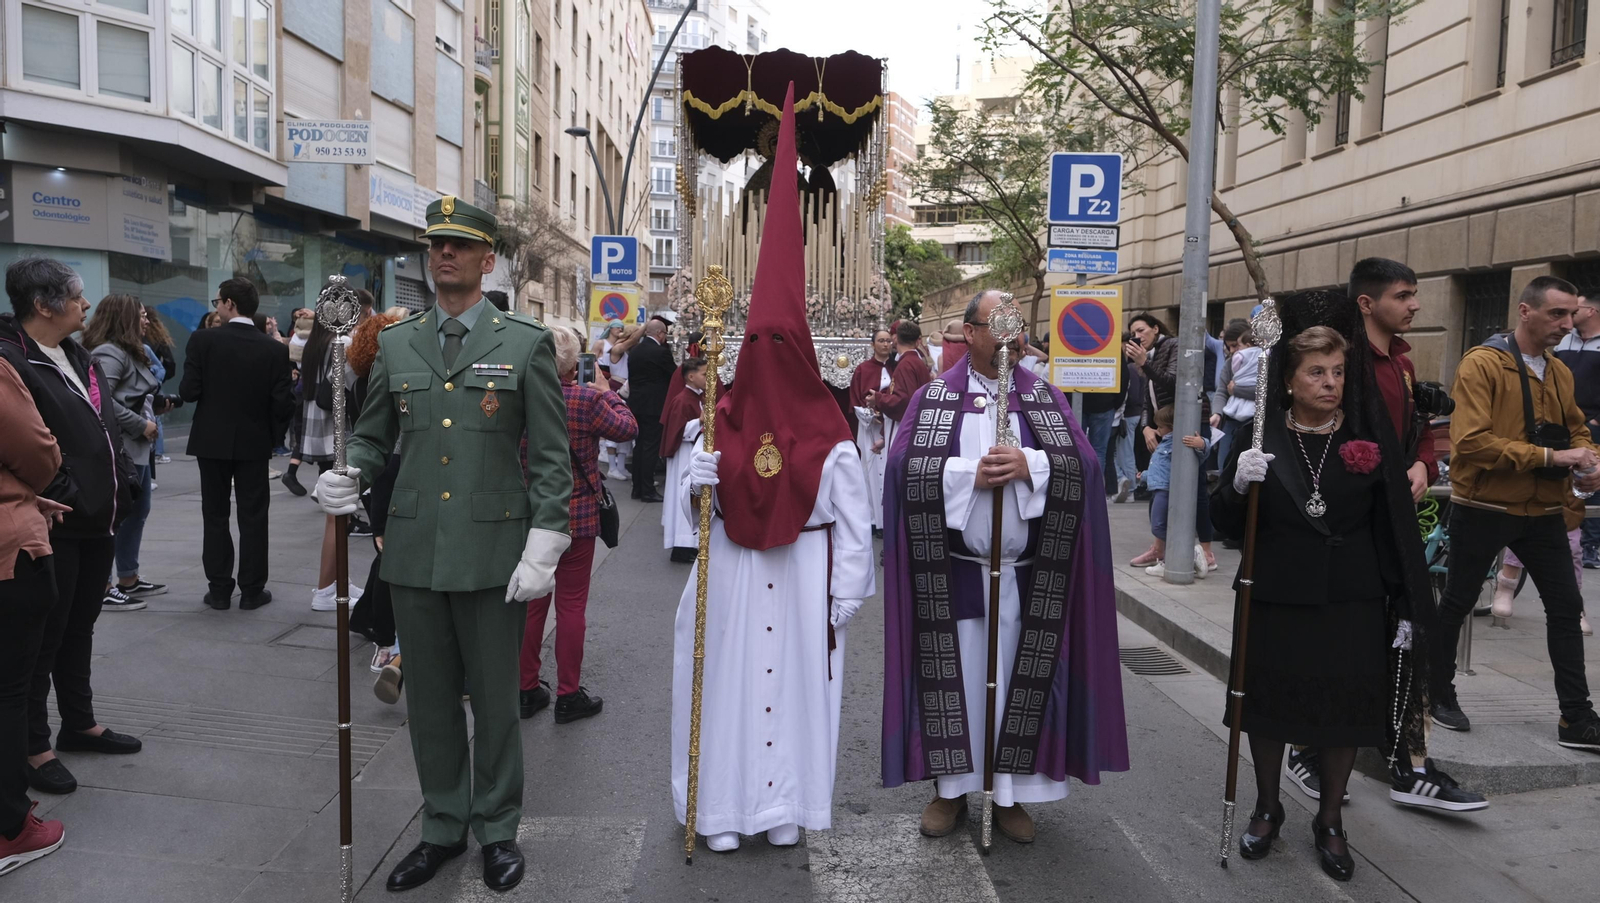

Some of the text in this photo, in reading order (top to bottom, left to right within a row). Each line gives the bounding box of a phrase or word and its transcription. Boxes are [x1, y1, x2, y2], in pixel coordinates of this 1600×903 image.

[288, 128, 369, 143] PODOCEN
[315, 147, 366, 157] 950 23 53 93
[1068, 164, 1104, 216] P
[32, 192, 80, 208] Centro
[1087, 198, 1111, 216] Z2
[33, 208, 90, 222] Odontológico
[601, 242, 624, 274] P
